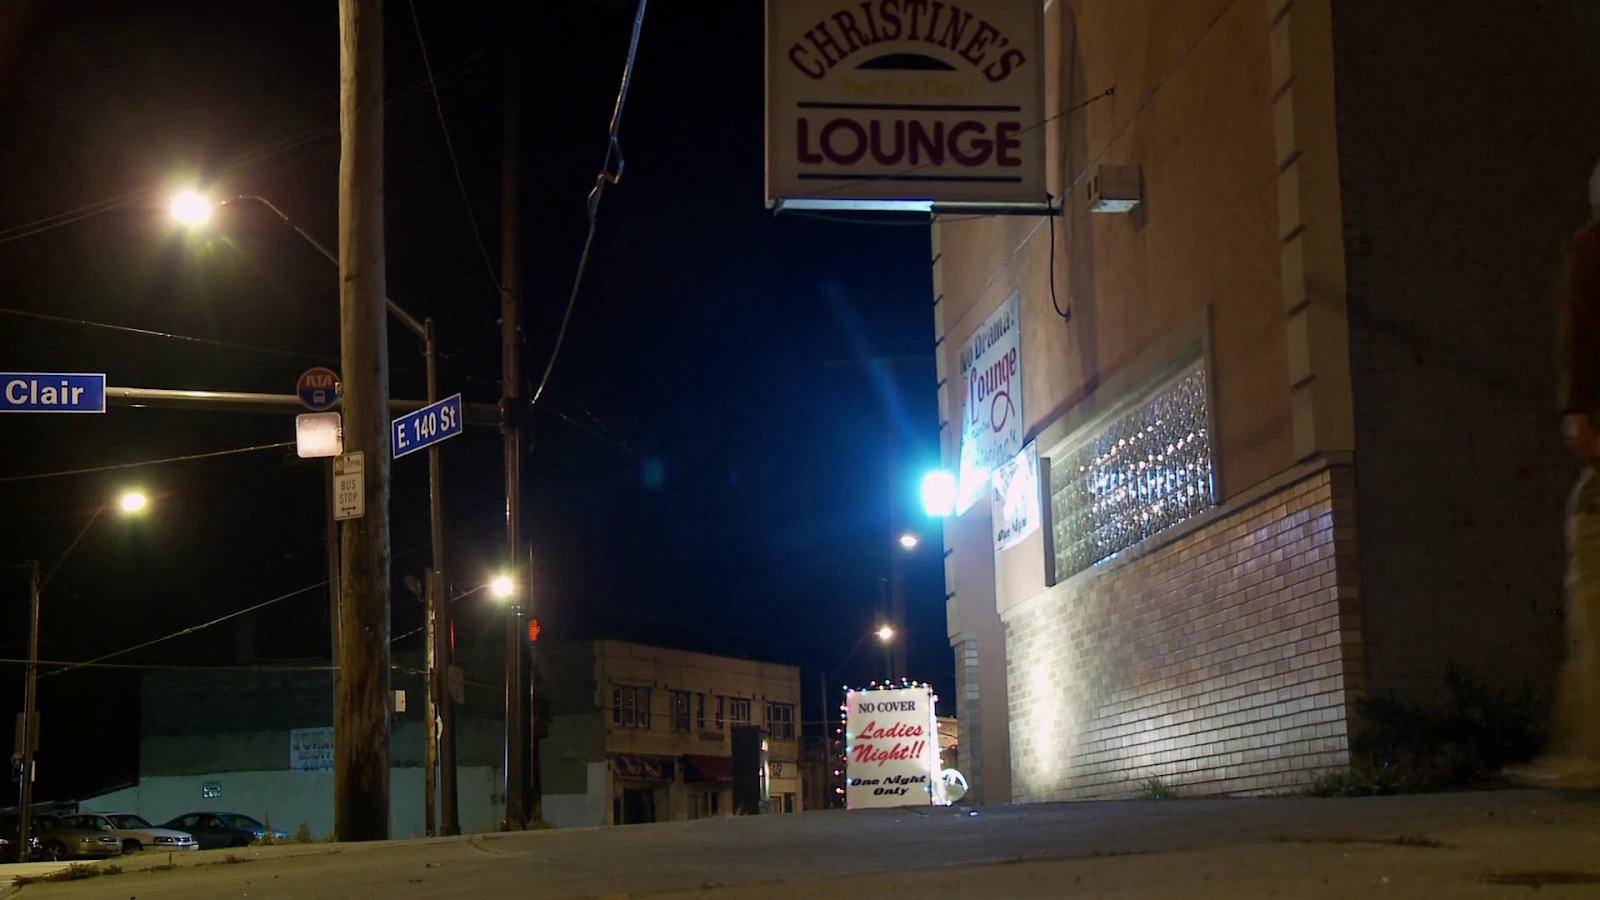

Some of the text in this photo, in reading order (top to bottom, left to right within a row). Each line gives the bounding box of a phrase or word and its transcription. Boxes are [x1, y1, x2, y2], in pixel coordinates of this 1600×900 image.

[788, 0, 1025, 82] CHRISTINE'S
[797, 118, 1022, 167] LOUNGE
[306, 374, 332, 387] RTA
[970, 347, 1017, 433] Lounge
[5, 379, 84, 405] Clair
[398, 405, 456, 449] E. 140 St
[341, 479, 356, 491] BUS
[339, 491, 358, 504] STOP
[858, 701, 916, 714] NO COVER
[855, 720, 924, 740] Ladies
[852, 740, 925, 767] Night!!
[851, 775, 926, 786] One Night
[873, 787, 909, 796] Only
